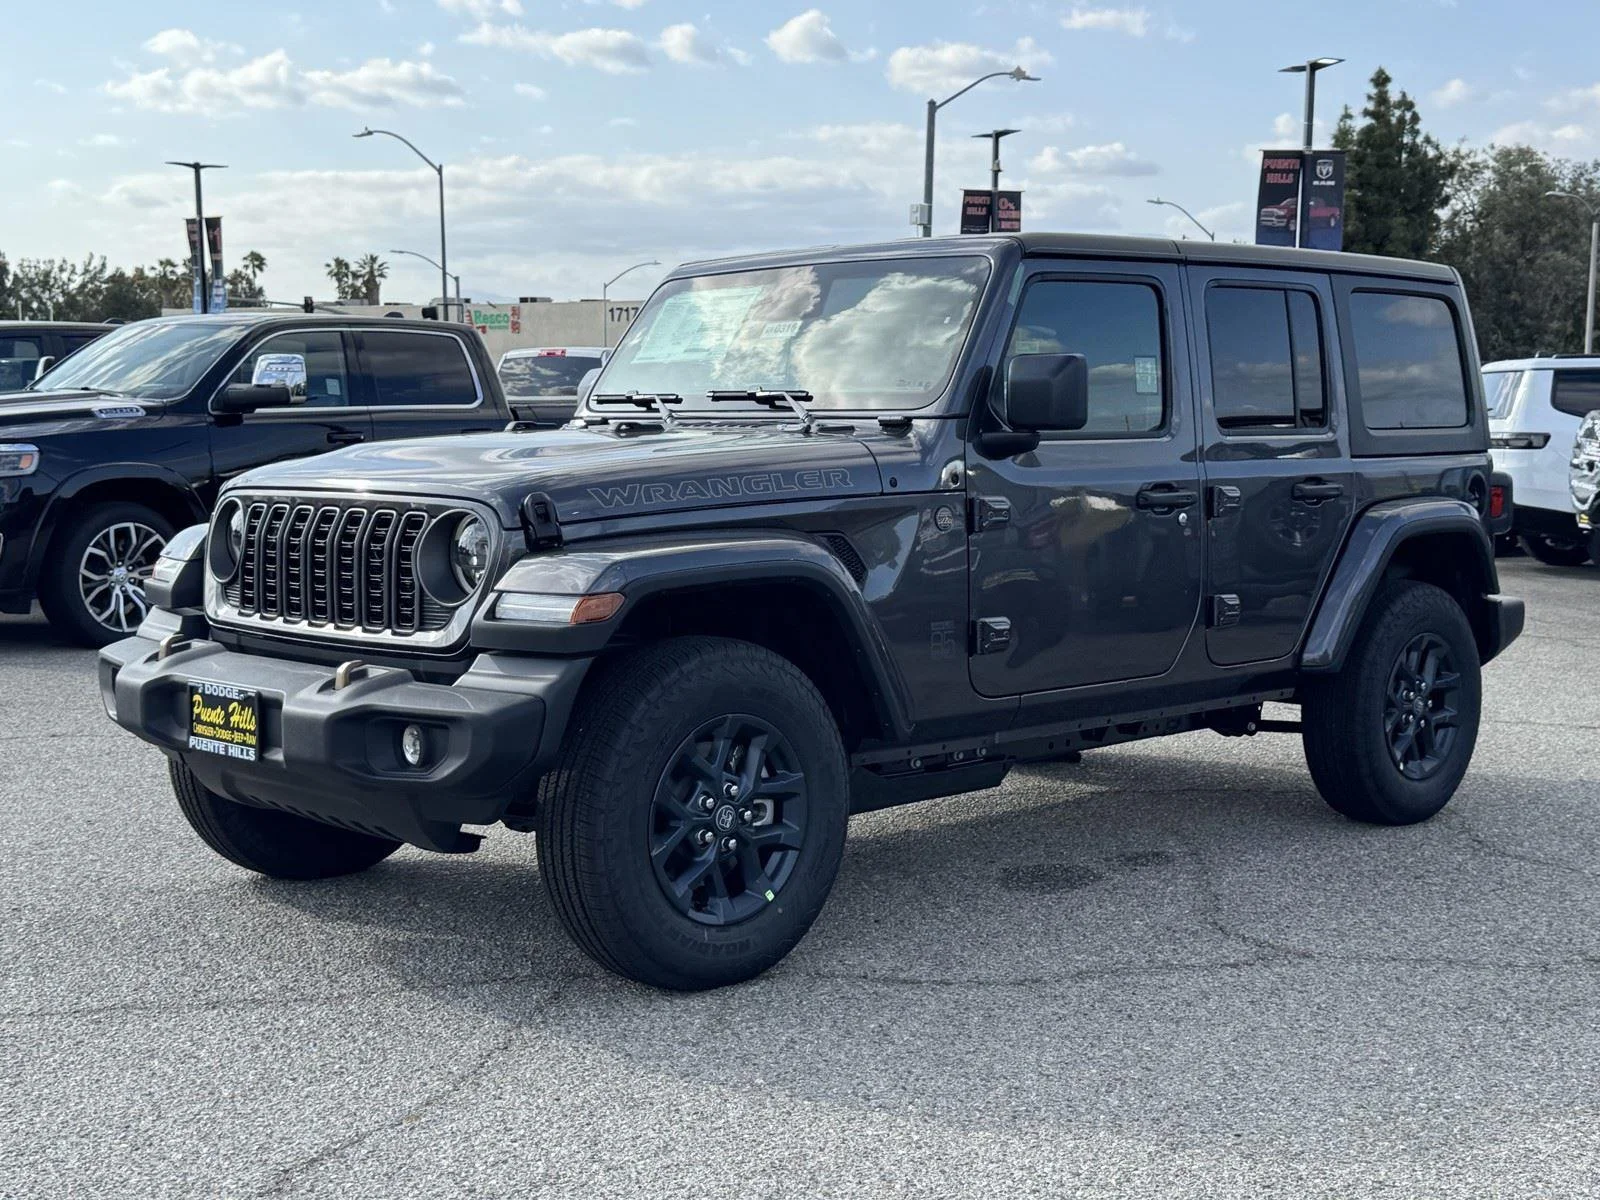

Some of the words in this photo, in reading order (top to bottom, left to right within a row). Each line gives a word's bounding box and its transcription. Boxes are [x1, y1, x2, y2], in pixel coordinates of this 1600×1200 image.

[587, 468, 854, 508] WRANGLER
[204, 683, 240, 700] DODGE
[193, 694, 226, 725] Puente
[228, 701, 256, 731] Hills
[188, 737, 226, 754] PUENTE
[228, 746, 256, 761] HILLS
